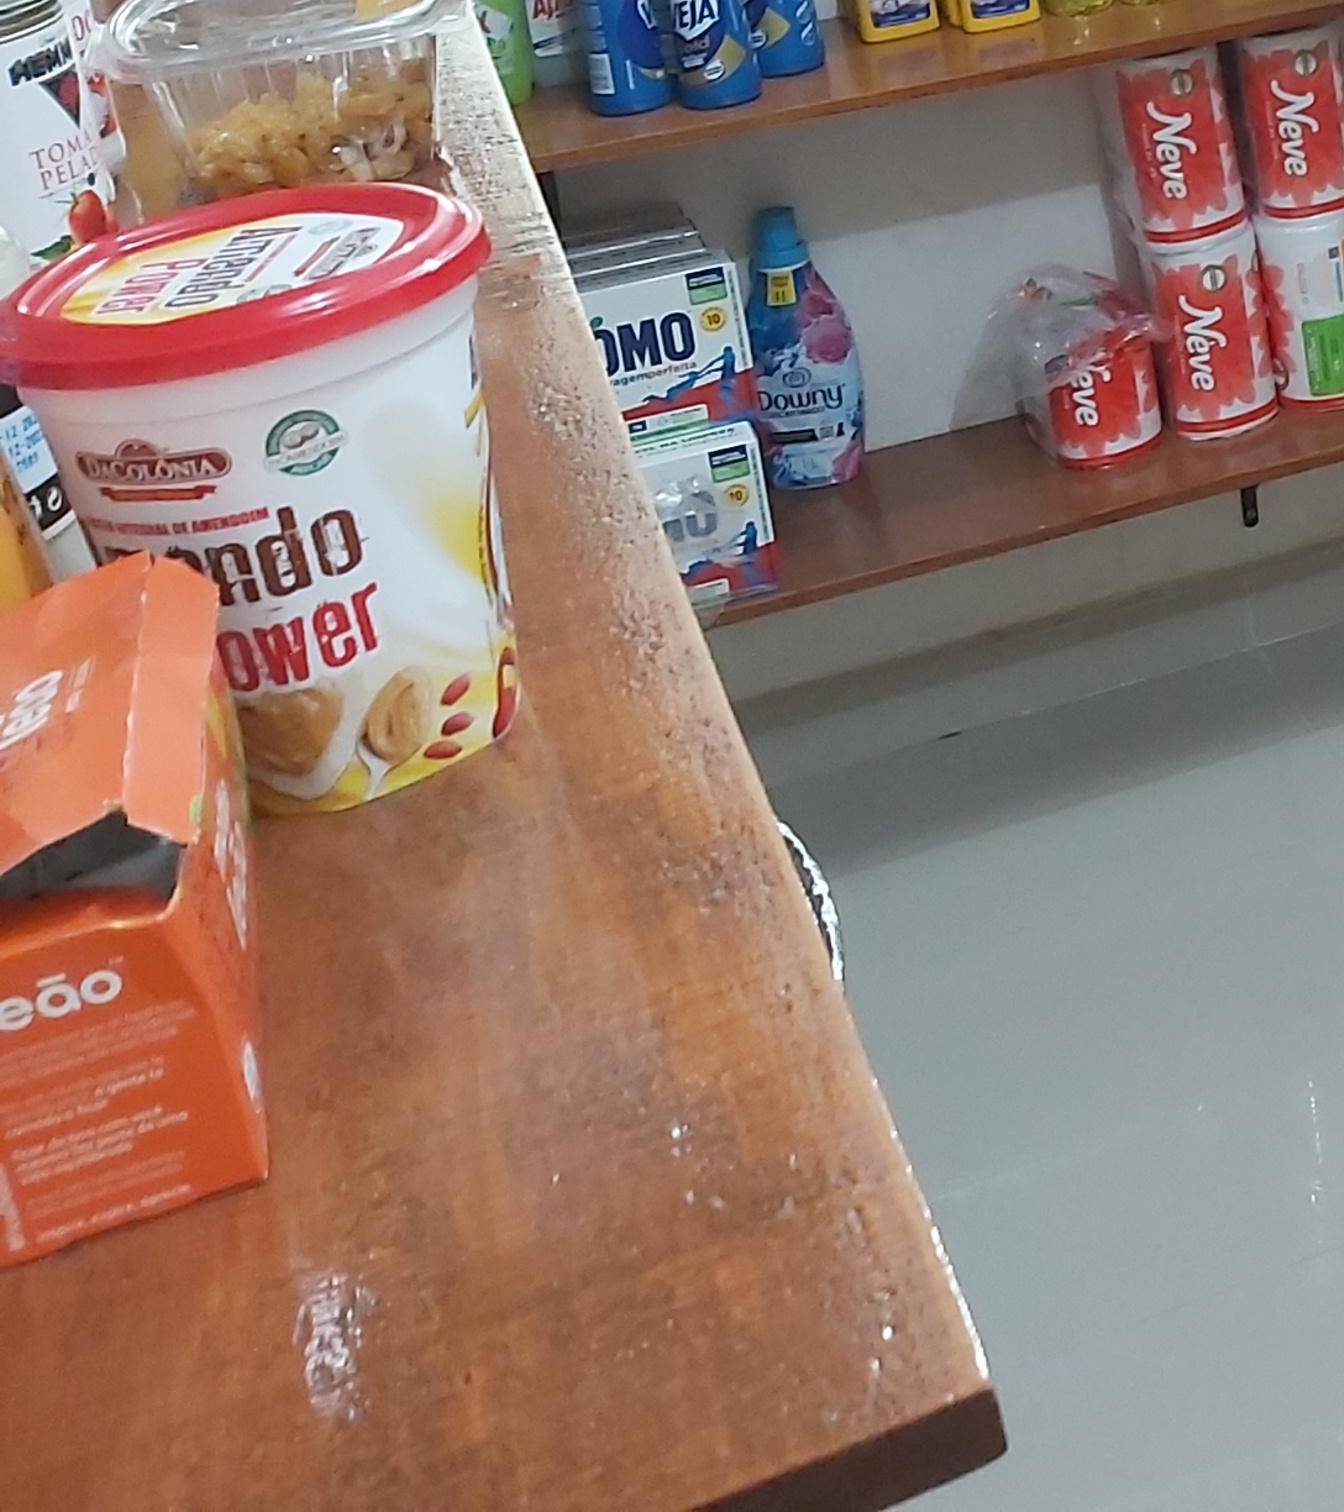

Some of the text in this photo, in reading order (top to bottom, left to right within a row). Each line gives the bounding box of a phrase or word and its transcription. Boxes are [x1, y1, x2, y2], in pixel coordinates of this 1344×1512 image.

[1146, 101, 1197, 200] Neve
[1271, 79, 1320, 178] Neve
[1178, 294, 1228, 392] Neve
[758, 384, 844, 413] Downy
[216, 582, 378, 692] ower
